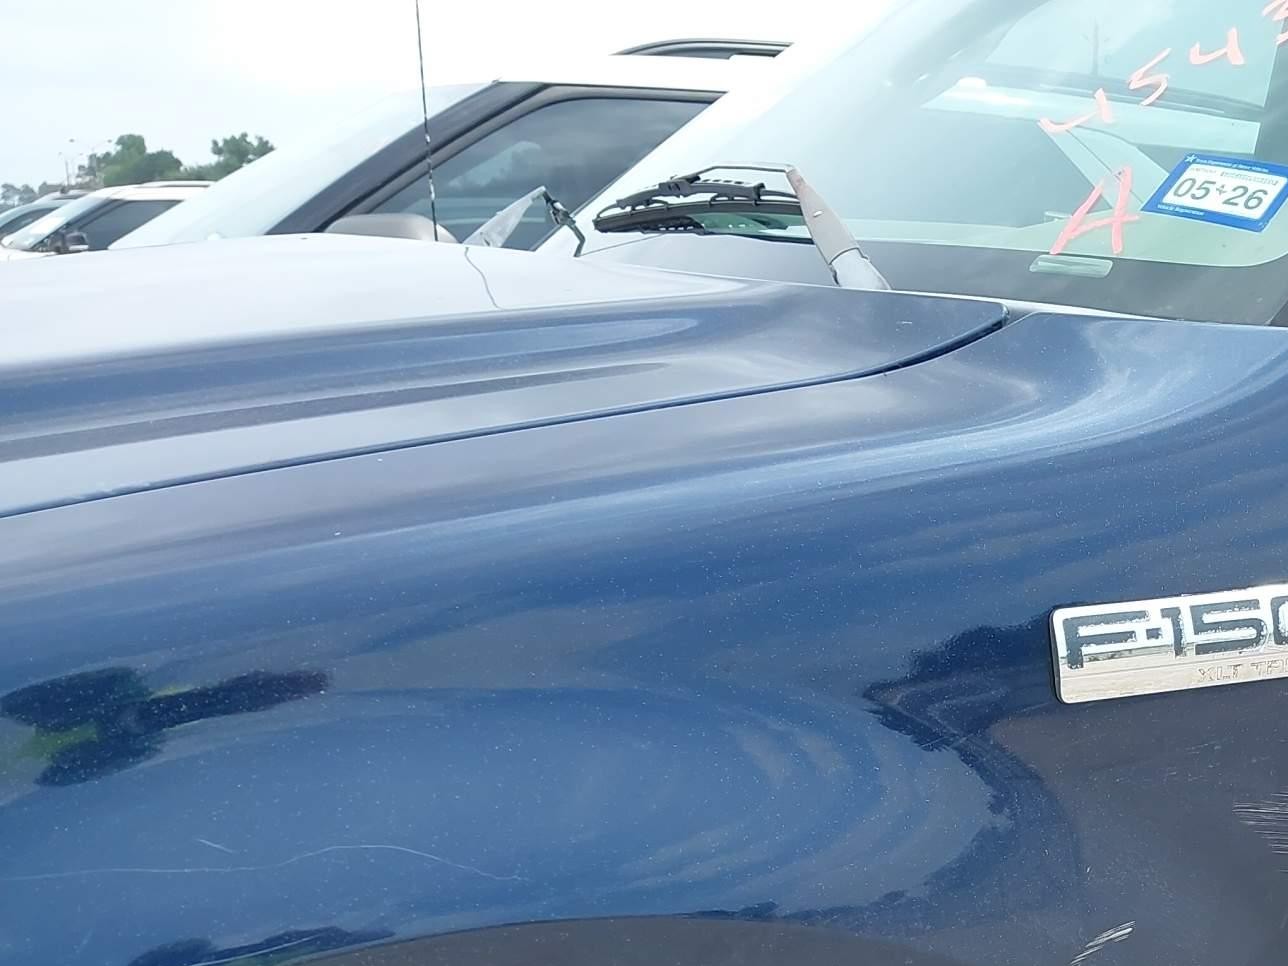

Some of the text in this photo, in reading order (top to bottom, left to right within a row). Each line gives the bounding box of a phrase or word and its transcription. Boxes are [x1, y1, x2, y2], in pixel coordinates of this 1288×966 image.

[1172, 177, 1217, 200] 05
[1222, 185, 1269, 210] 26
[1049, 167, 1141, 255] A
[1197, 663, 1243, 682] XLT
